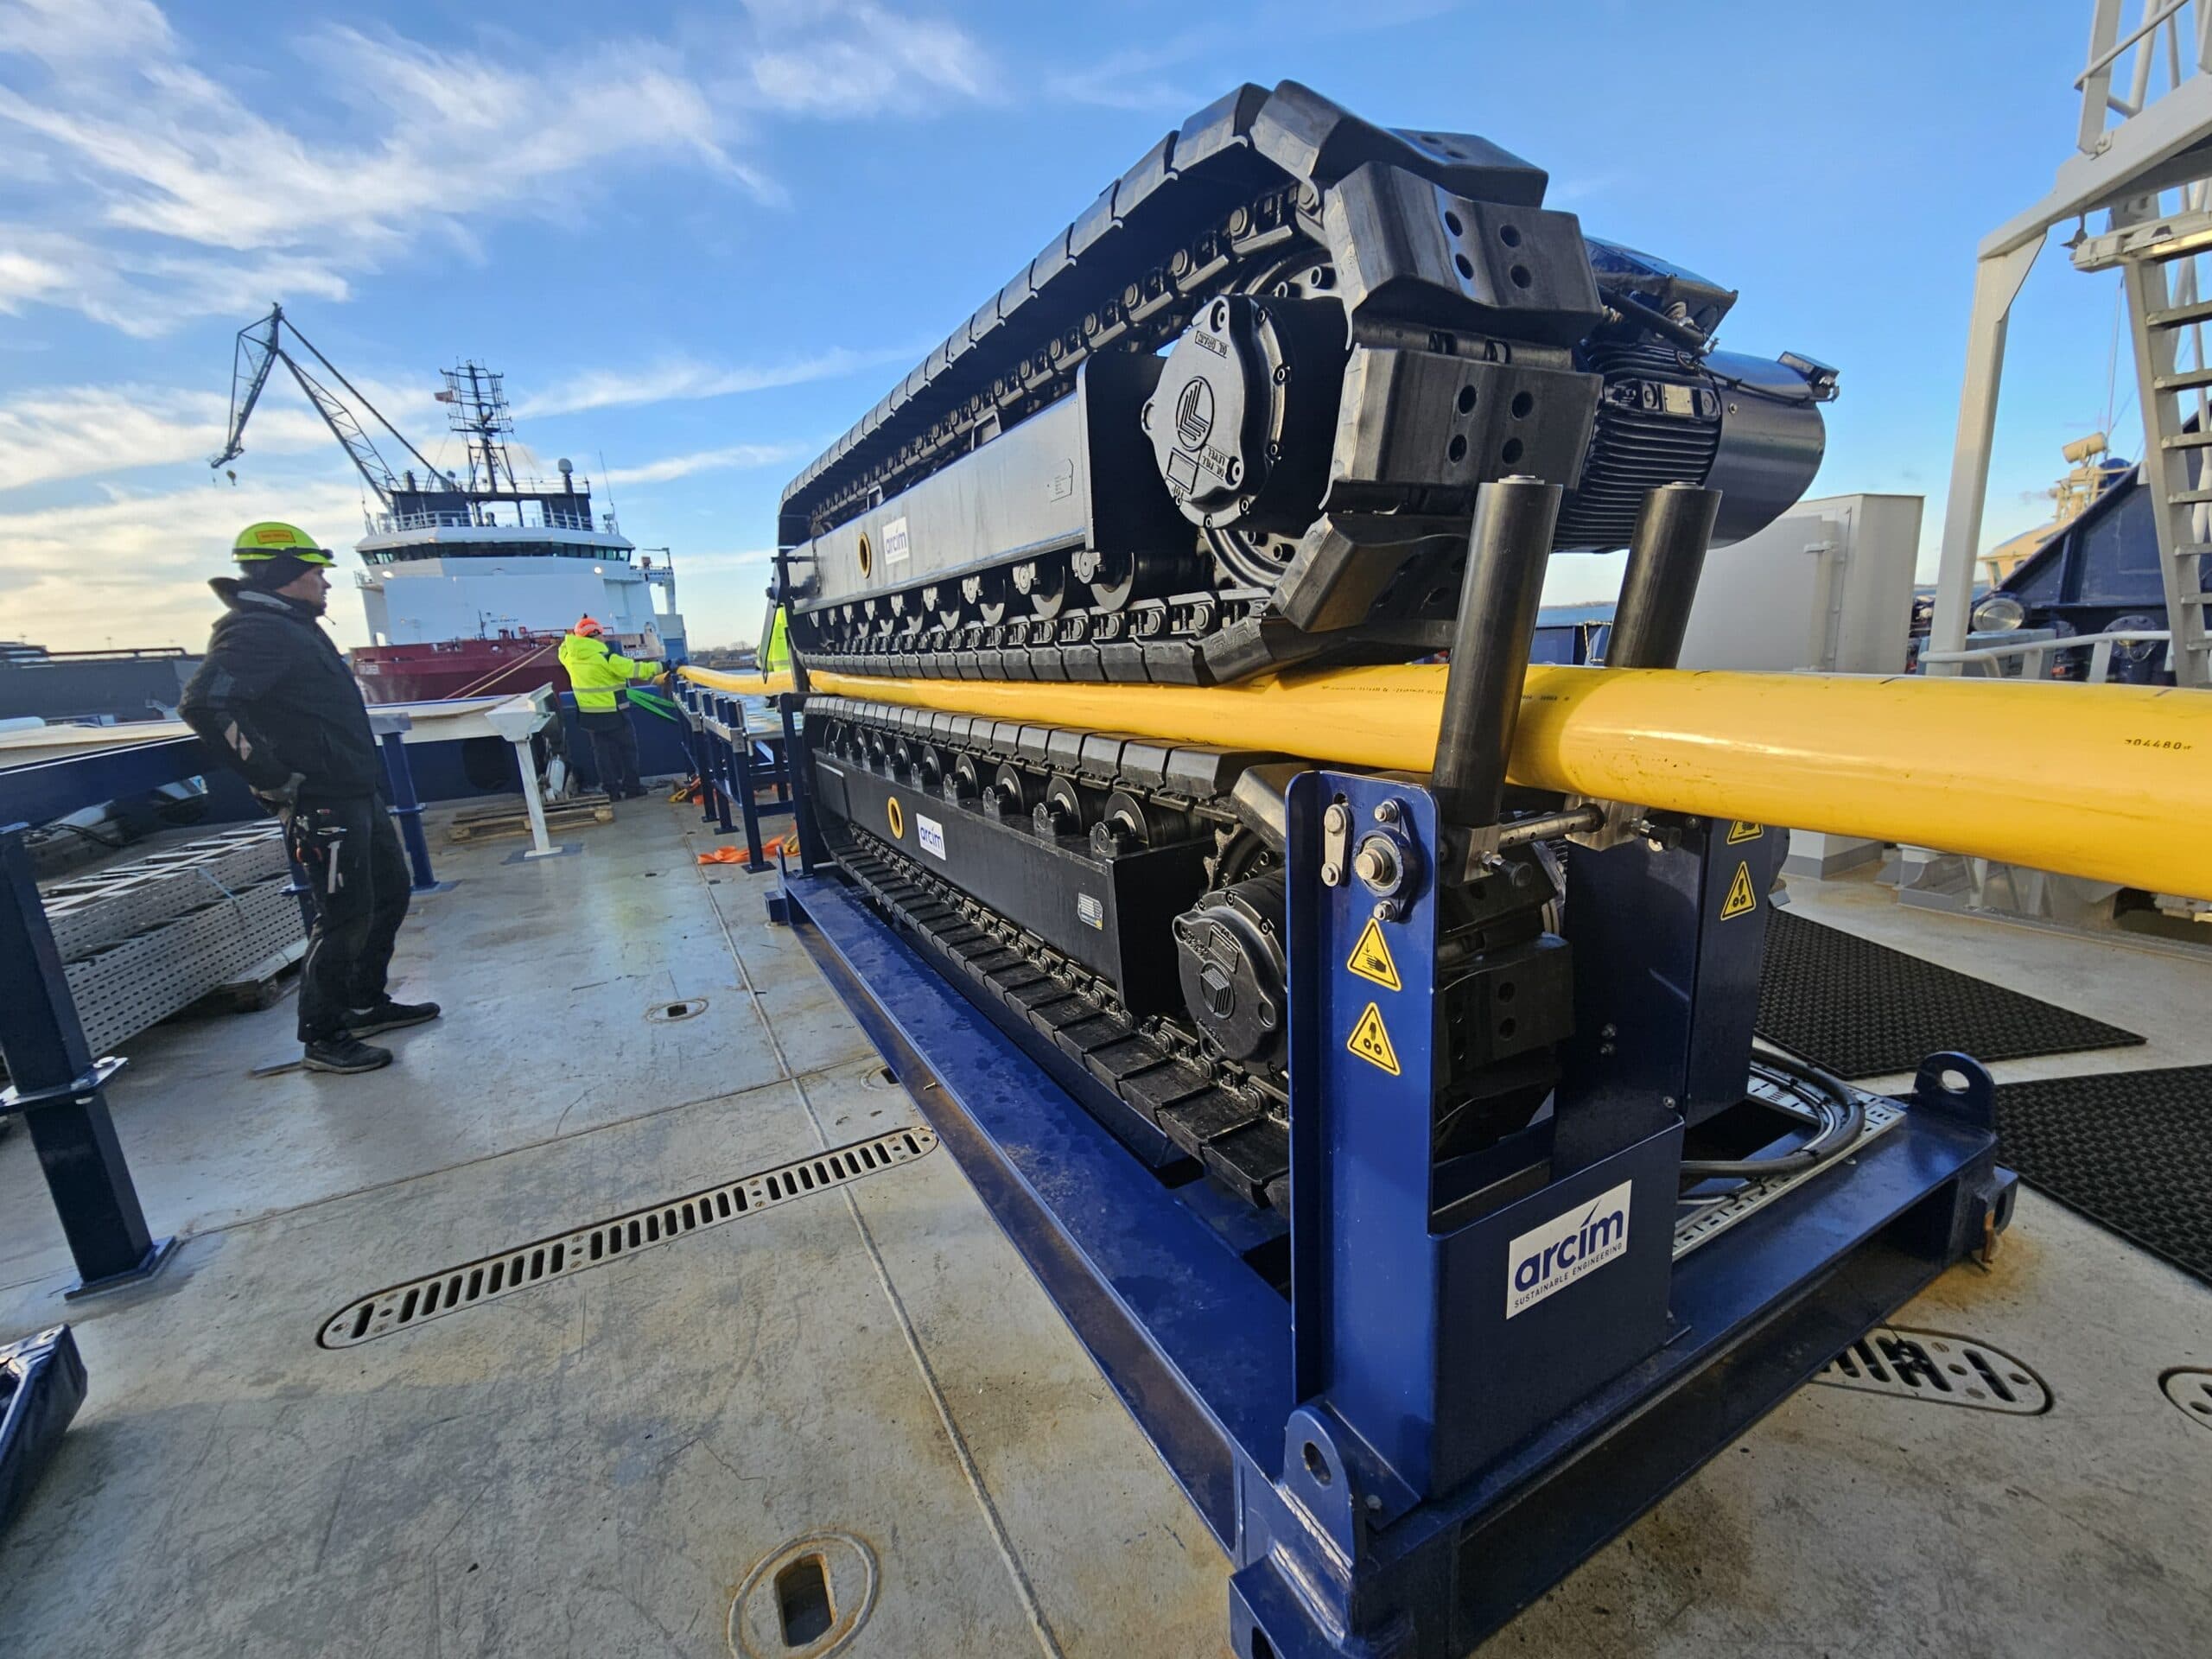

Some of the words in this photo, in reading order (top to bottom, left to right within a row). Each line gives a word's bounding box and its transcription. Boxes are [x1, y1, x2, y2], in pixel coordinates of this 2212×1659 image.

[886, 525, 907, 554] arcim
[920, 826, 944, 851] arcim
[1515, 1198, 1624, 1292] arcim
[1514, 1271, 1569, 1309] SUSTAINABLE
[1572, 1242, 1623, 1276] ENGINEERING
